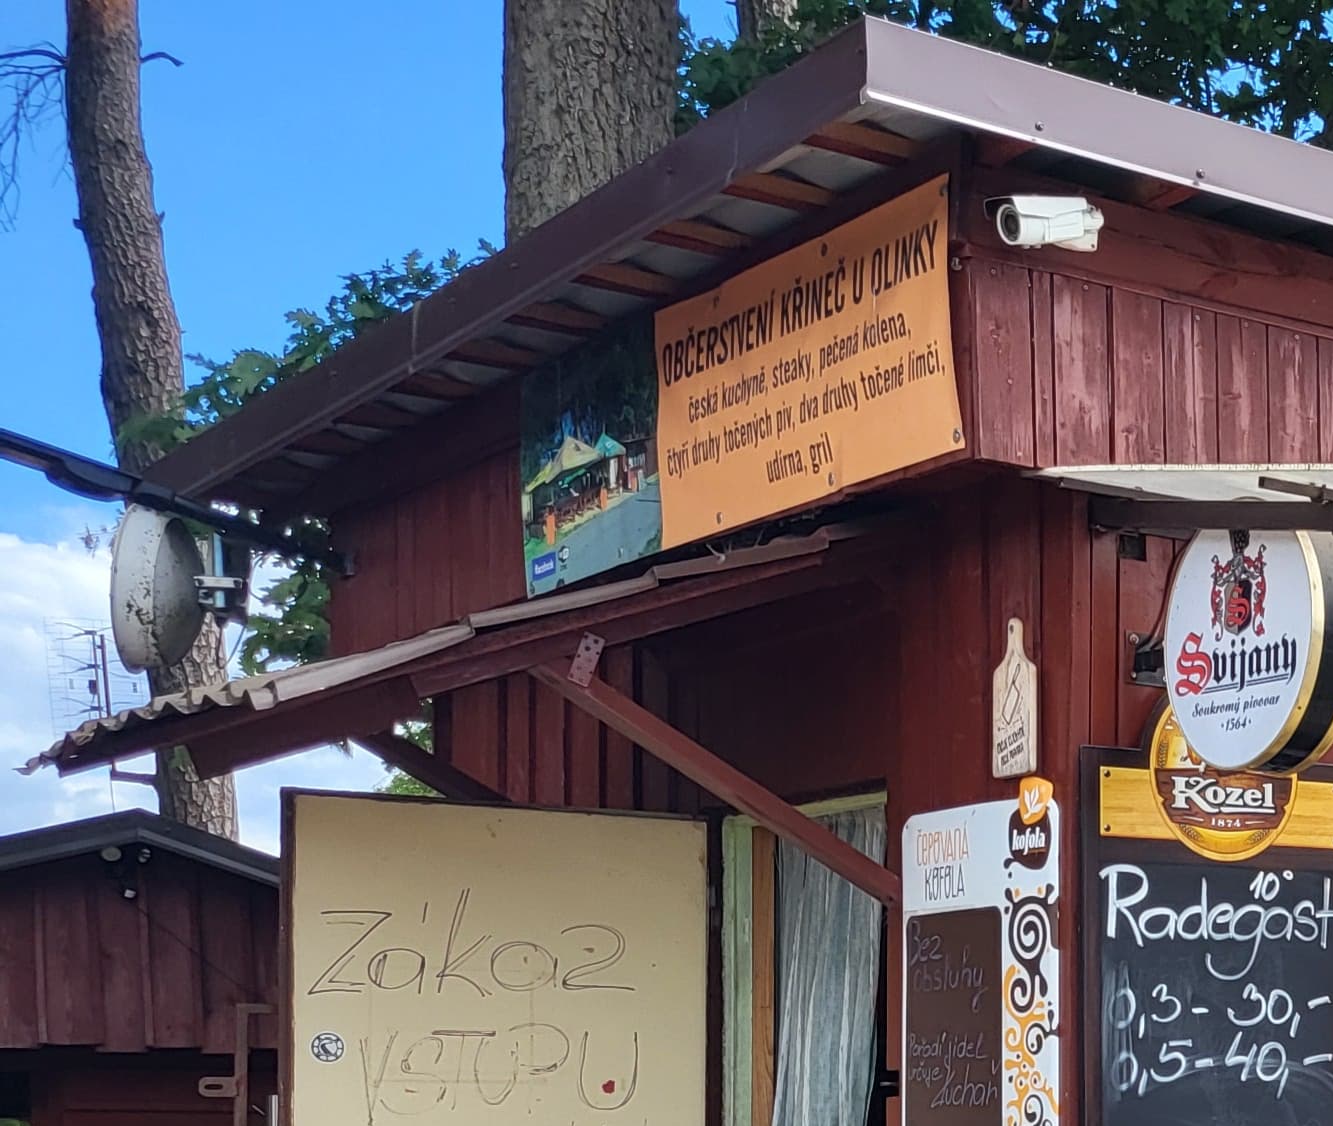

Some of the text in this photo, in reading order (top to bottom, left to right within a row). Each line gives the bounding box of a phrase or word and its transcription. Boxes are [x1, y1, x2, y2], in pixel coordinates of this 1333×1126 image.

[663, 221, 939, 387] OBČERSTVENÍ KŘINEČ U OLINKY
[688, 311, 912, 424] česká kuchyně, steaky, pečená kolena,
[692, 422, 721, 470] druhy
[724, 402, 772, 456] točených
[800, 392, 819, 425] dva
[822, 376, 858, 416] druhy
[860, 359, 904, 401] točené
[766, 432, 833, 485] udírna, gril
[1175, 631, 1298, 697] Svijany
[1191, 694, 1281, 718] Soukromý pivovar
[1225, 716, 1247, 732] 1564
[1170, 776, 1276, 814] Kozel
[916, 820, 969, 867] ČEPOVANÁ
[1012, 827, 1046, 856] kofola
[1211, 817, 1241, 828] 1874
[924, 864, 966, 901] KOFOLA
[308, 888, 636, 998] Zákaz
